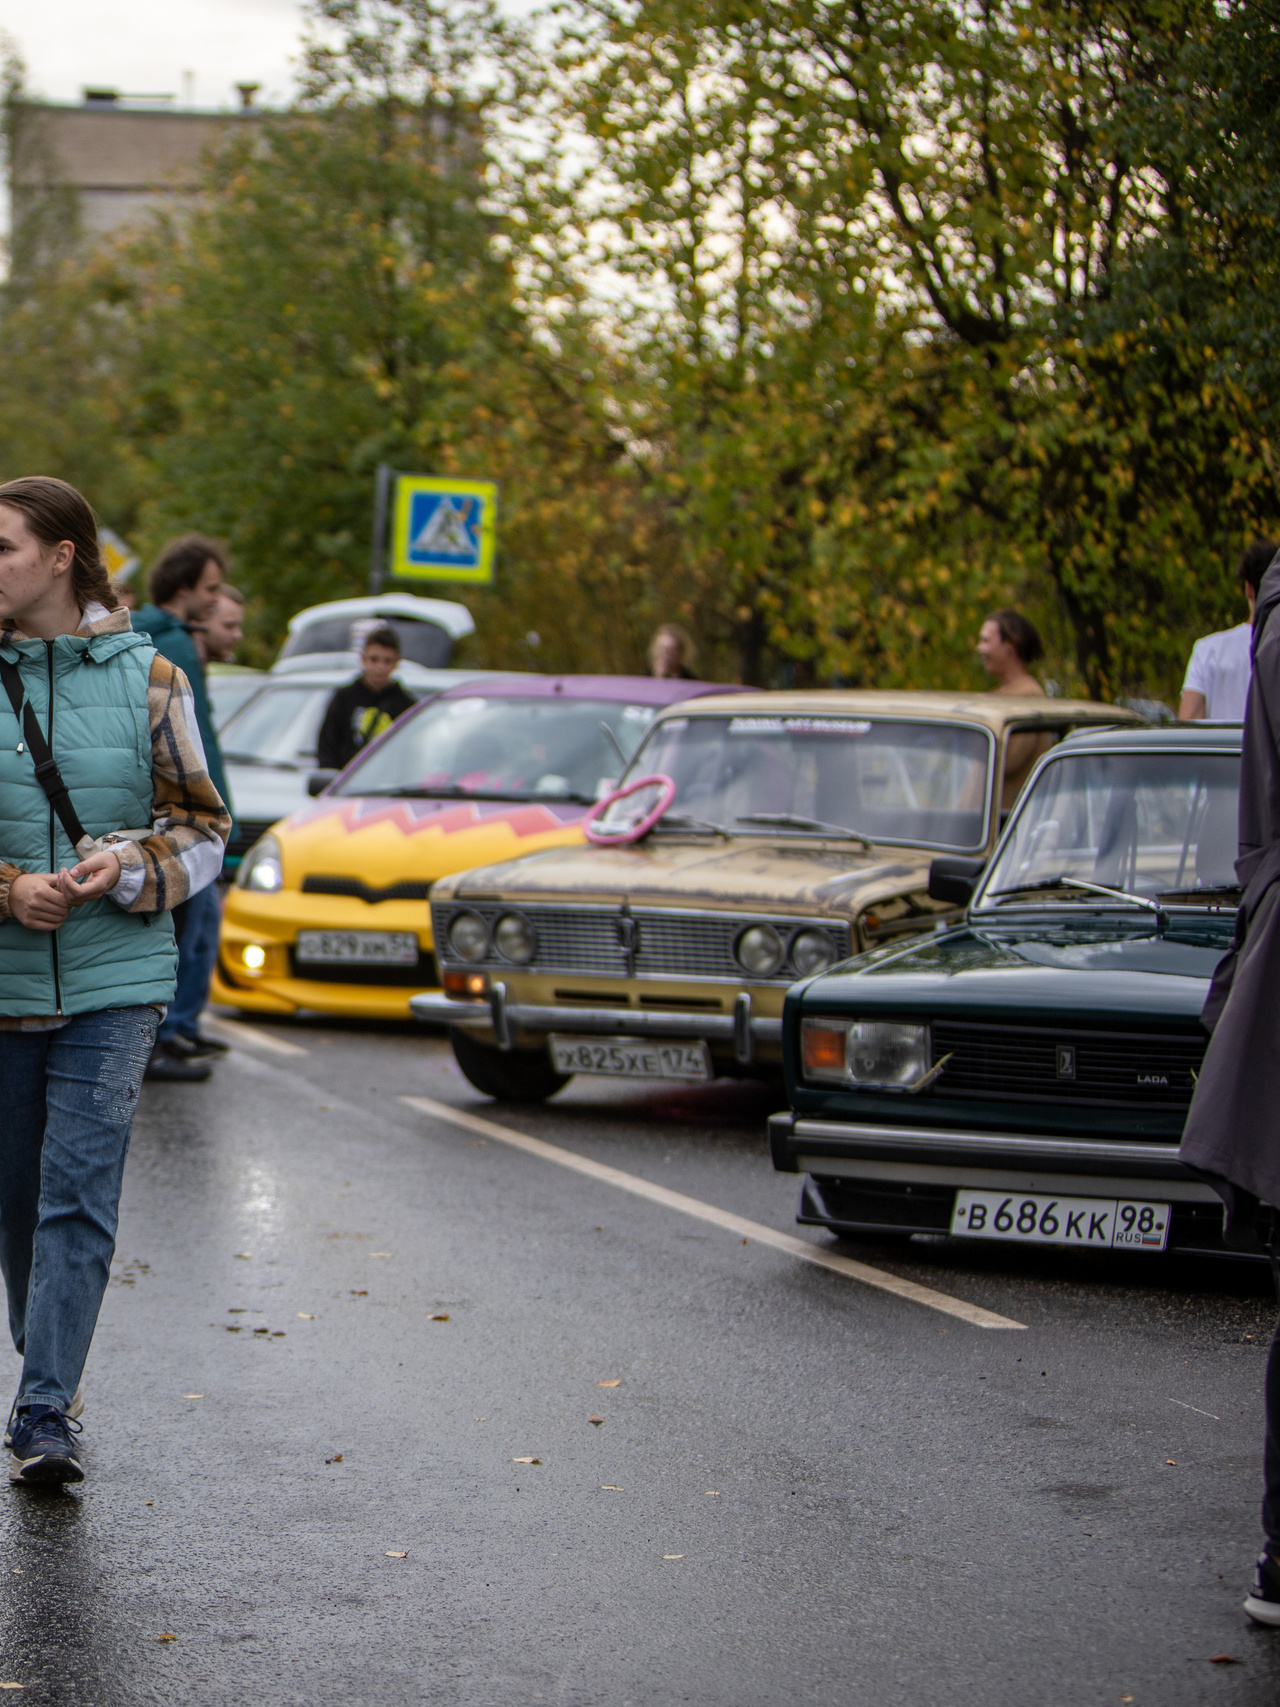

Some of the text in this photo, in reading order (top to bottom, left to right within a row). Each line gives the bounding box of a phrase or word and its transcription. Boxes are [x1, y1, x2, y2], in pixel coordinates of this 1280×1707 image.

[1137, 1074, 1168, 1085] LADA
[1120, 1205, 1155, 1233] 98
[1115, 1232, 1142, 1244] RUS
